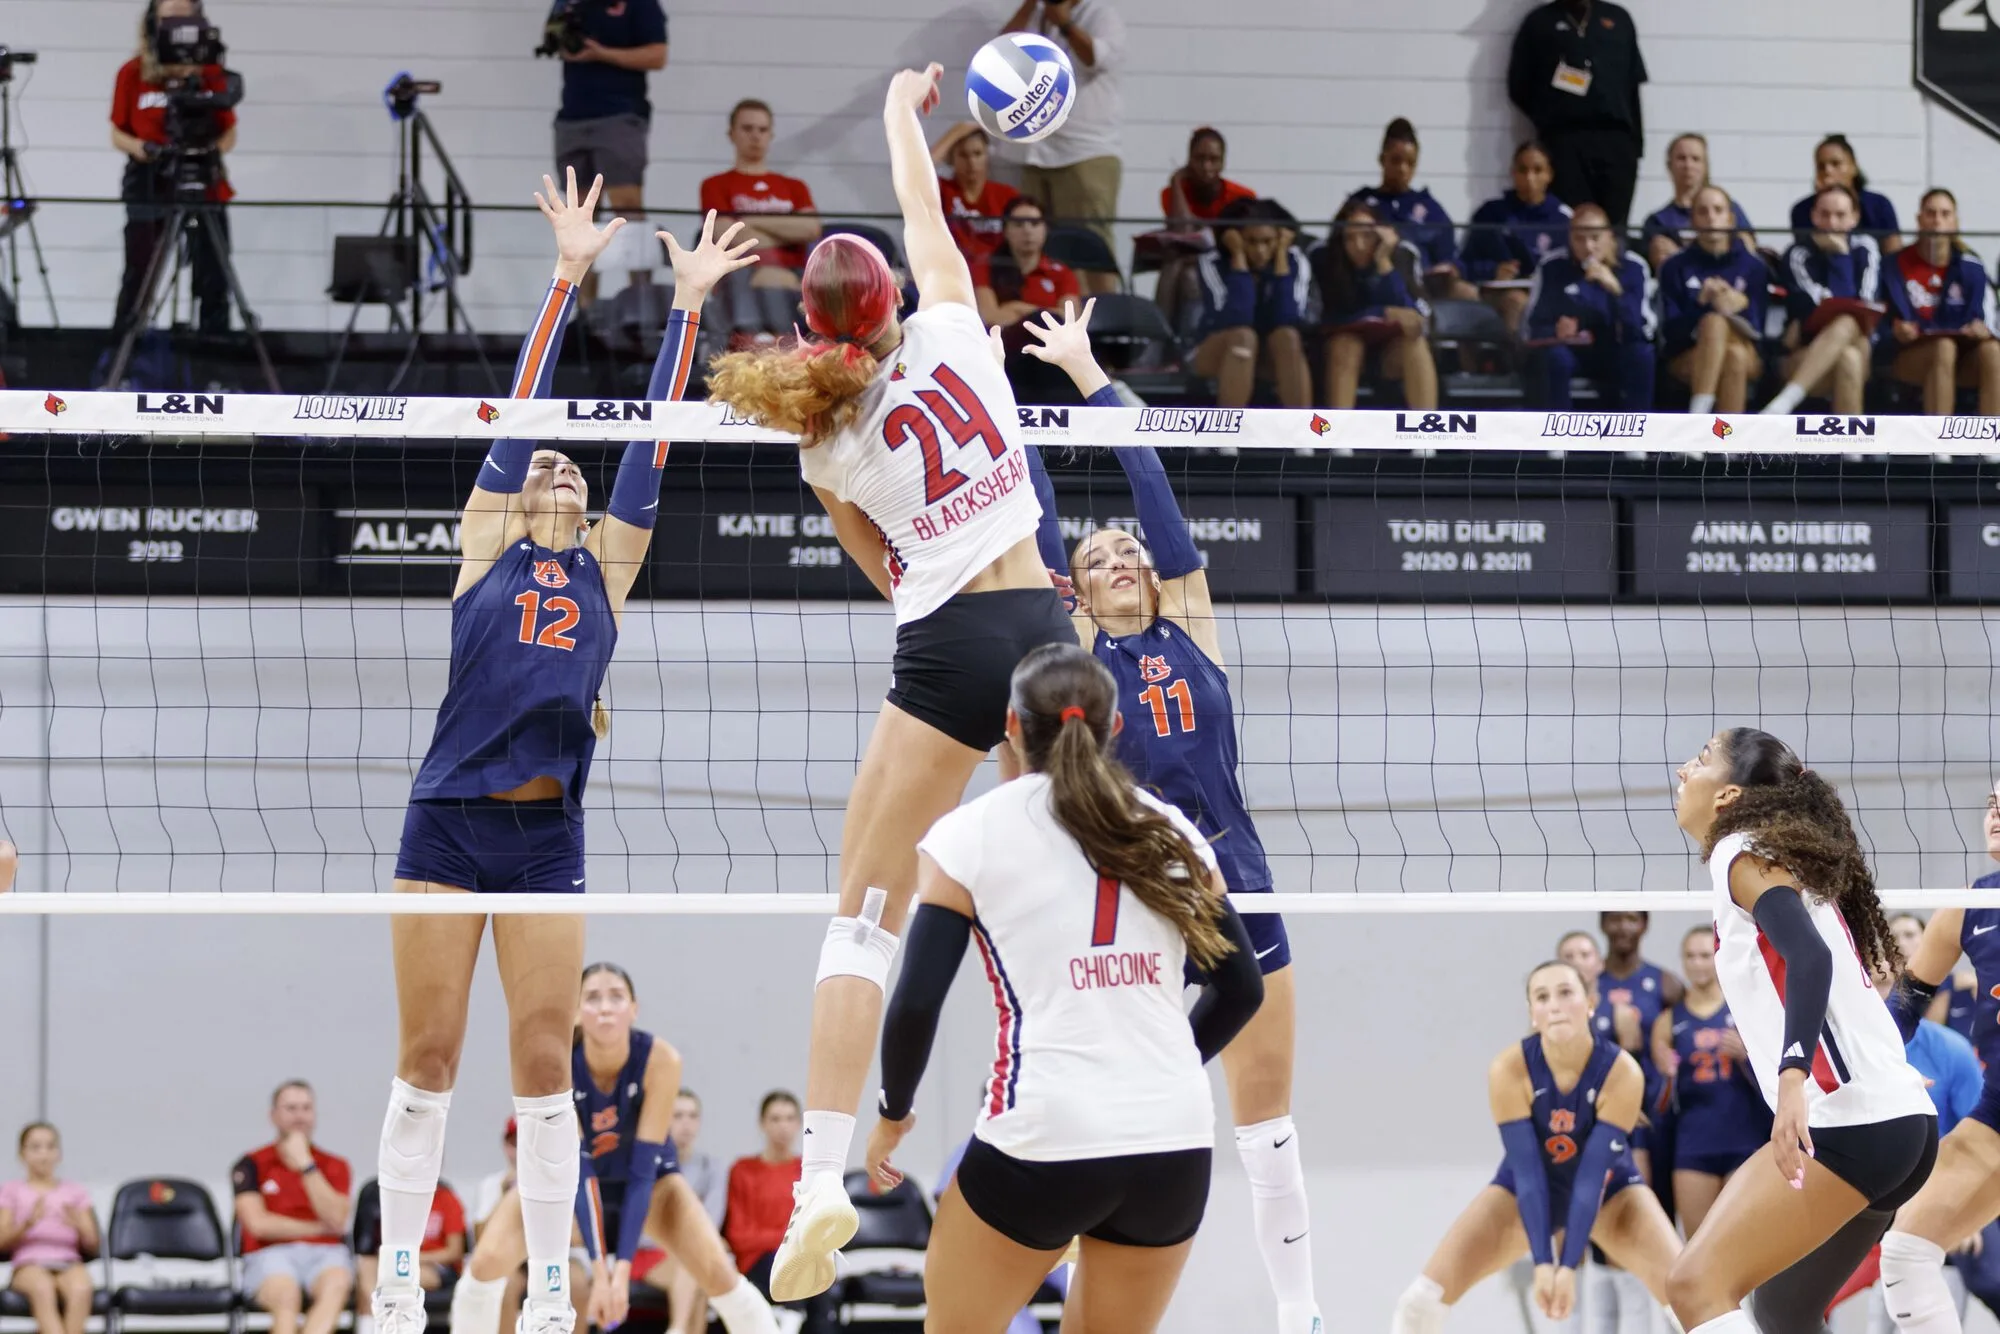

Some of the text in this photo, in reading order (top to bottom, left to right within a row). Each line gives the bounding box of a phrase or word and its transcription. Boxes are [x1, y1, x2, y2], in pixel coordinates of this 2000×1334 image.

[1008, 74, 1052, 124] molten
[137, 394, 224, 414] L&N
[293, 395, 408, 423] LOUISVILLE
[567, 401, 652, 421] L&N
[1017, 408, 1069, 428] &N
[1135, 409, 1244, 436] LOUISVILLE
[1396, 413, 1477, 433] L&N
[1541, 414, 1647, 440] LOUISVILLE
[1796, 416, 1876, 436] L&N
[883, 362, 1007, 507] 24
[912, 449, 1027, 541] BLACKSHEAR
[51, 508, 259, 532] GWEN RUCKER
[718, 514, 796, 537] KATIE
[1387, 519, 1547, 543] TORI DILFER
[1690, 521, 1872, 545] ANNA DEBEER
[127, 540, 184, 563] 2012
[788, 546, 842, 567] 2015
[1401, 551, 1459, 571] 2020
[1821, 552, 1877, 572] 2024
[514, 590, 580, 652] 12
[1138, 679, 1195, 737] 11
[1070, 952, 1161, 991] CHICOINE
[1690, 1050, 1733, 1083] 21
[1545, 1135, 1577, 1165] 9
